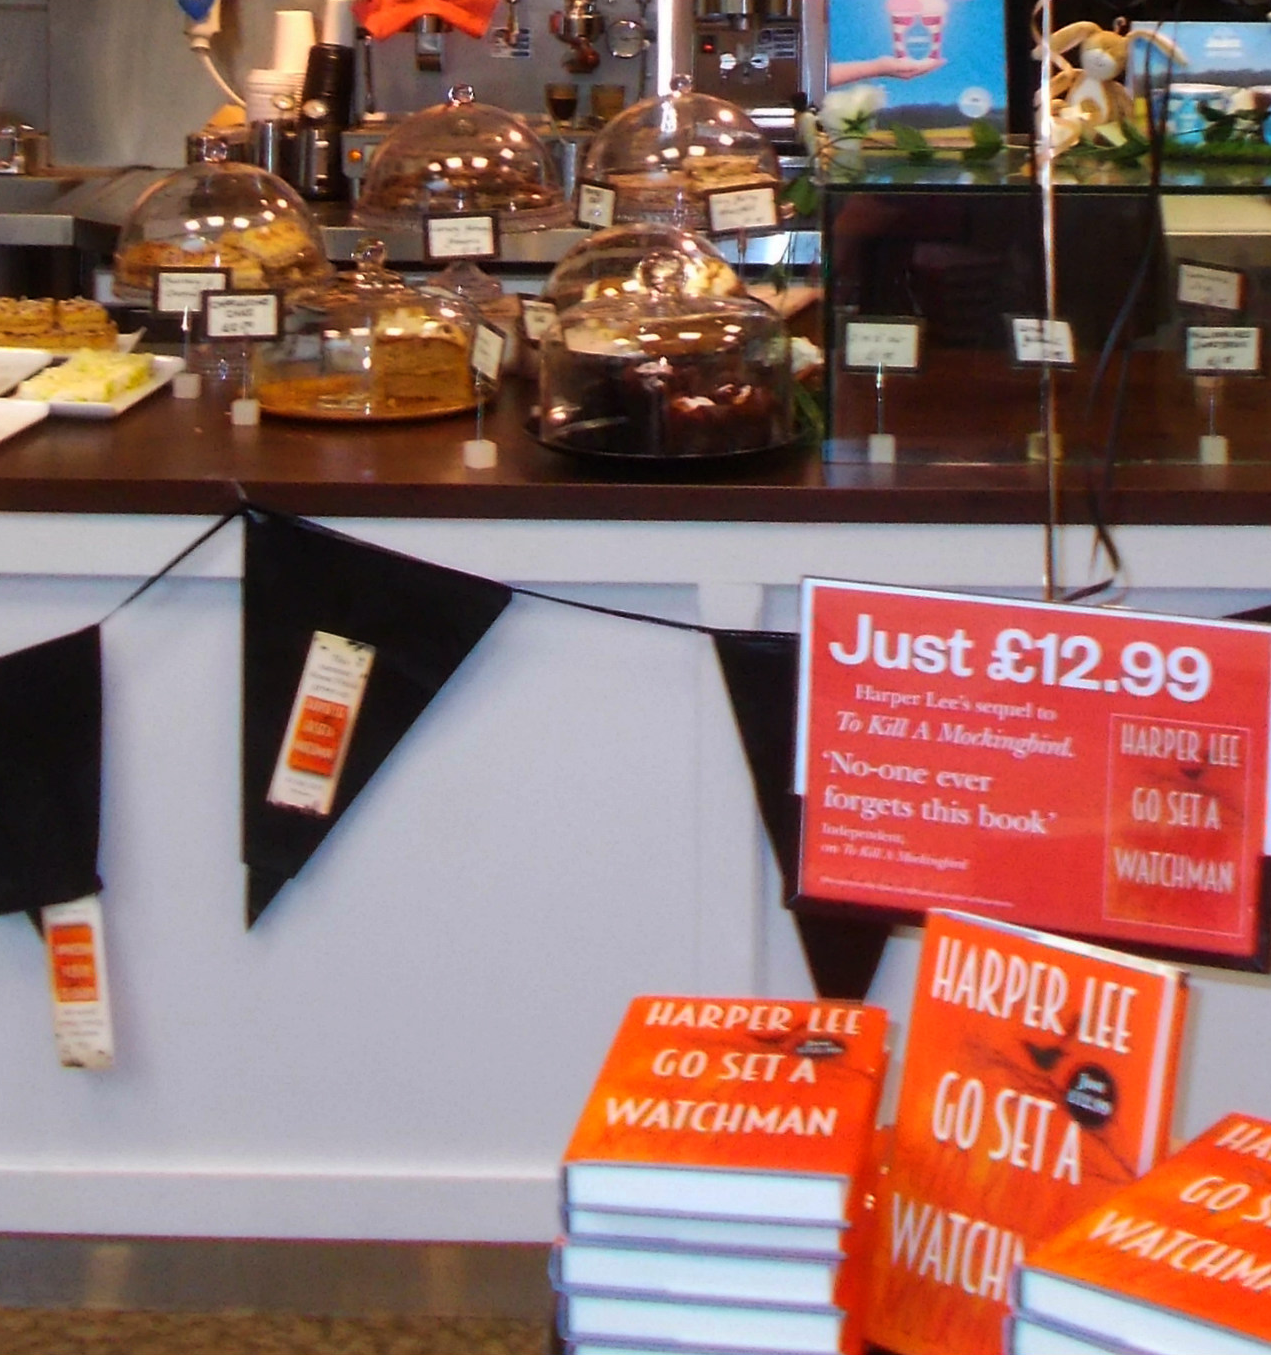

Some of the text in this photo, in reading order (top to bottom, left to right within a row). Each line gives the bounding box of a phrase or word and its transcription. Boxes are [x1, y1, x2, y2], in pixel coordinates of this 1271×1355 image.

[829, 613, 1212, 702] Just £12.99
[855, 683, 1058, 722] Harper Lee's sequel to
[836, 710, 1076, 759] To Kill A Mockingbird.
[1121, 723, 1241, 768] HARPER LEE
[936, 770, 993, 793] ever
[823, 786, 914, 820] forgets
[921, 797, 971, 826] this
[1132, 787, 1221, 831] GO SET A
[1114, 847, 1234, 895] WATCHMAN
[931, 935, 1139, 1054] HARPER LEE
[645, 1001, 864, 1035] HARPER LEE
[651, 1048, 818, 1084] GO SET A
[605, 1096, 839, 1137] WATCHMAN
[931, 1070, 984, 1151] GO
[987, 1088, 1057, 1173] SET
[1052, 1120, 1081, 1185] A
[1179, 1174, 1252, 1213] GO
[891, 1192, 1027, 1304] WATCH
